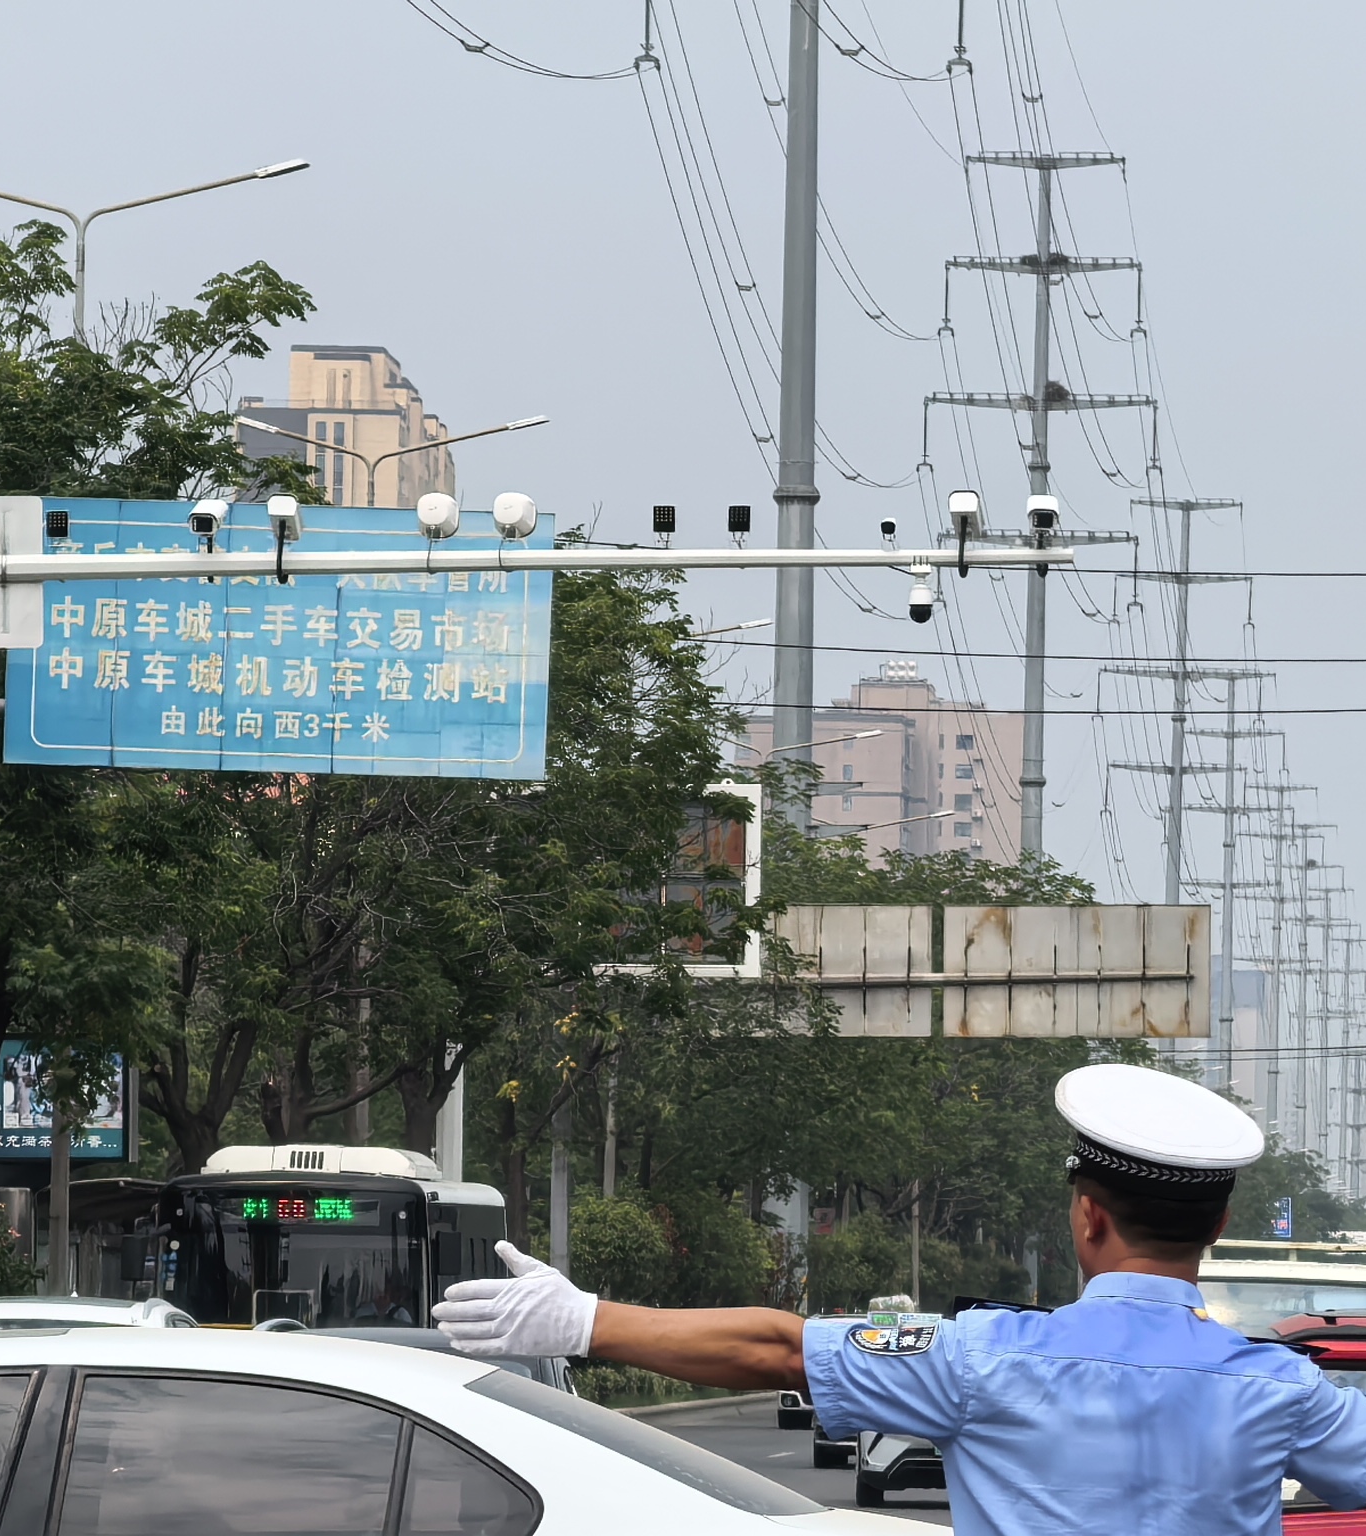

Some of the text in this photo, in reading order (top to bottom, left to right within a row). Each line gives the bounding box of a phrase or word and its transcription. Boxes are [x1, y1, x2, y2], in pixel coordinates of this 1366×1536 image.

[49, 595, 511, 652] 中原车城二手车交易市场
[48, 648, 510, 704] 中原车城机动车检测站
[161, 706, 391, 742] 由此向西3千米
